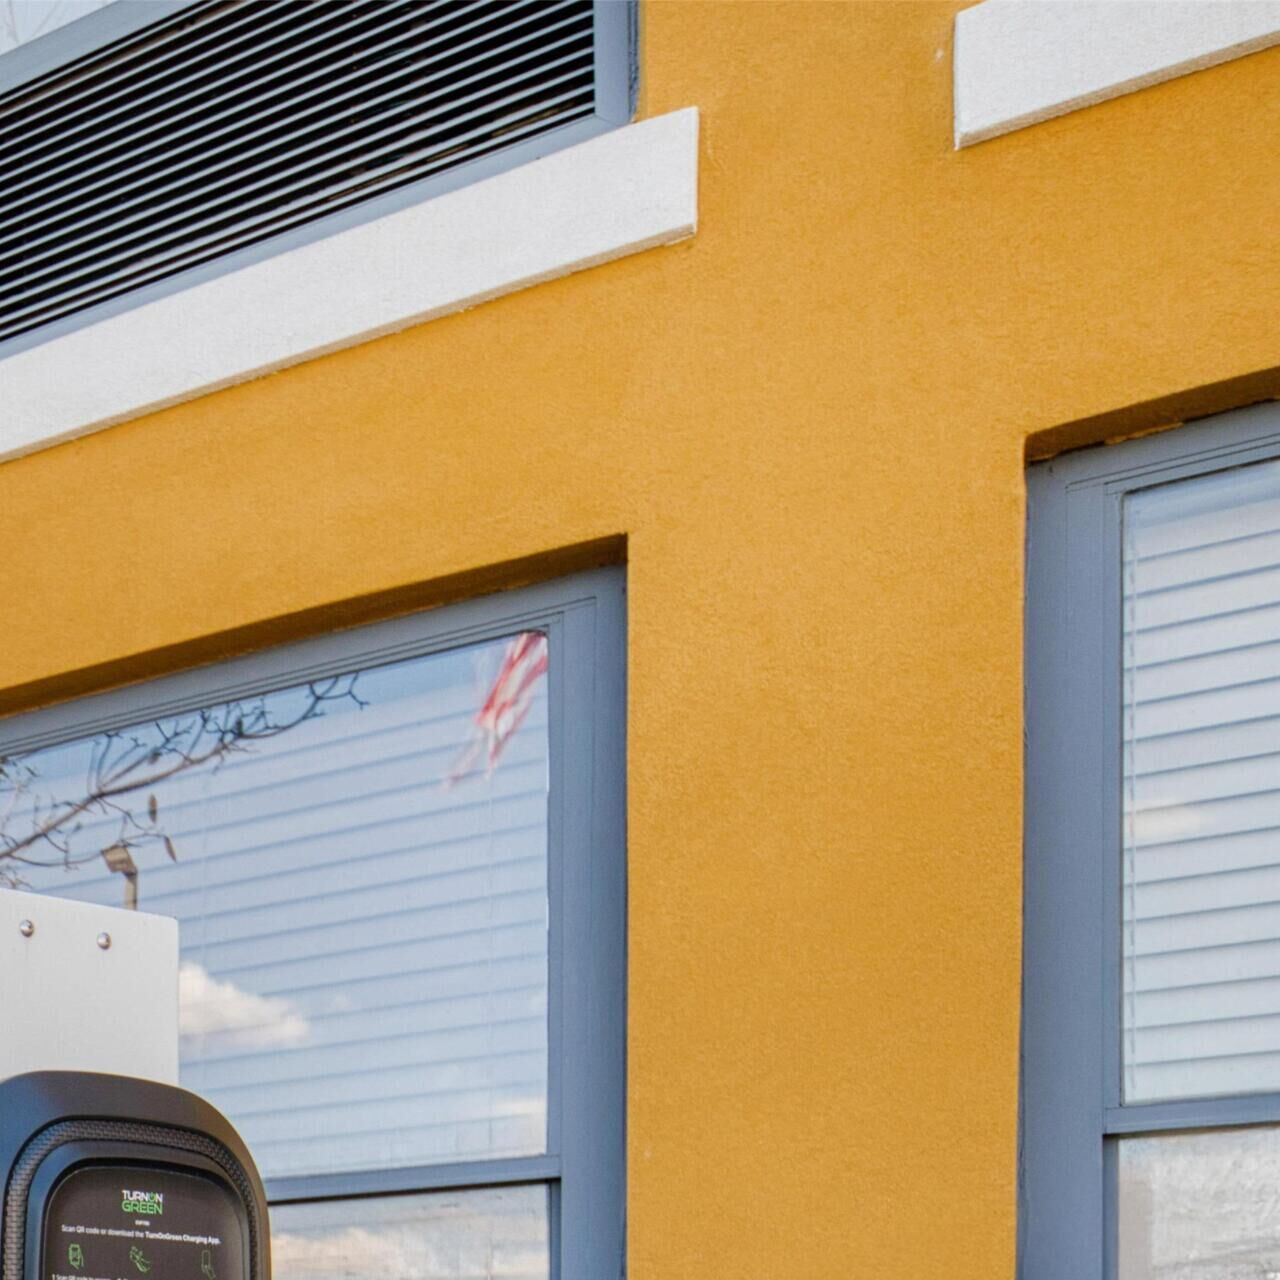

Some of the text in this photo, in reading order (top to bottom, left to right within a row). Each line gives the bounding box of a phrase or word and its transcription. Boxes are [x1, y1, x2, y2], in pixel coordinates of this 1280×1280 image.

[122, 1190, 163, 1203] TURNON
[122, 1200, 163, 1215] GREEN
[61, 1224, 75, 1233] Scan
[76, 1225, 85, 1233] QR
